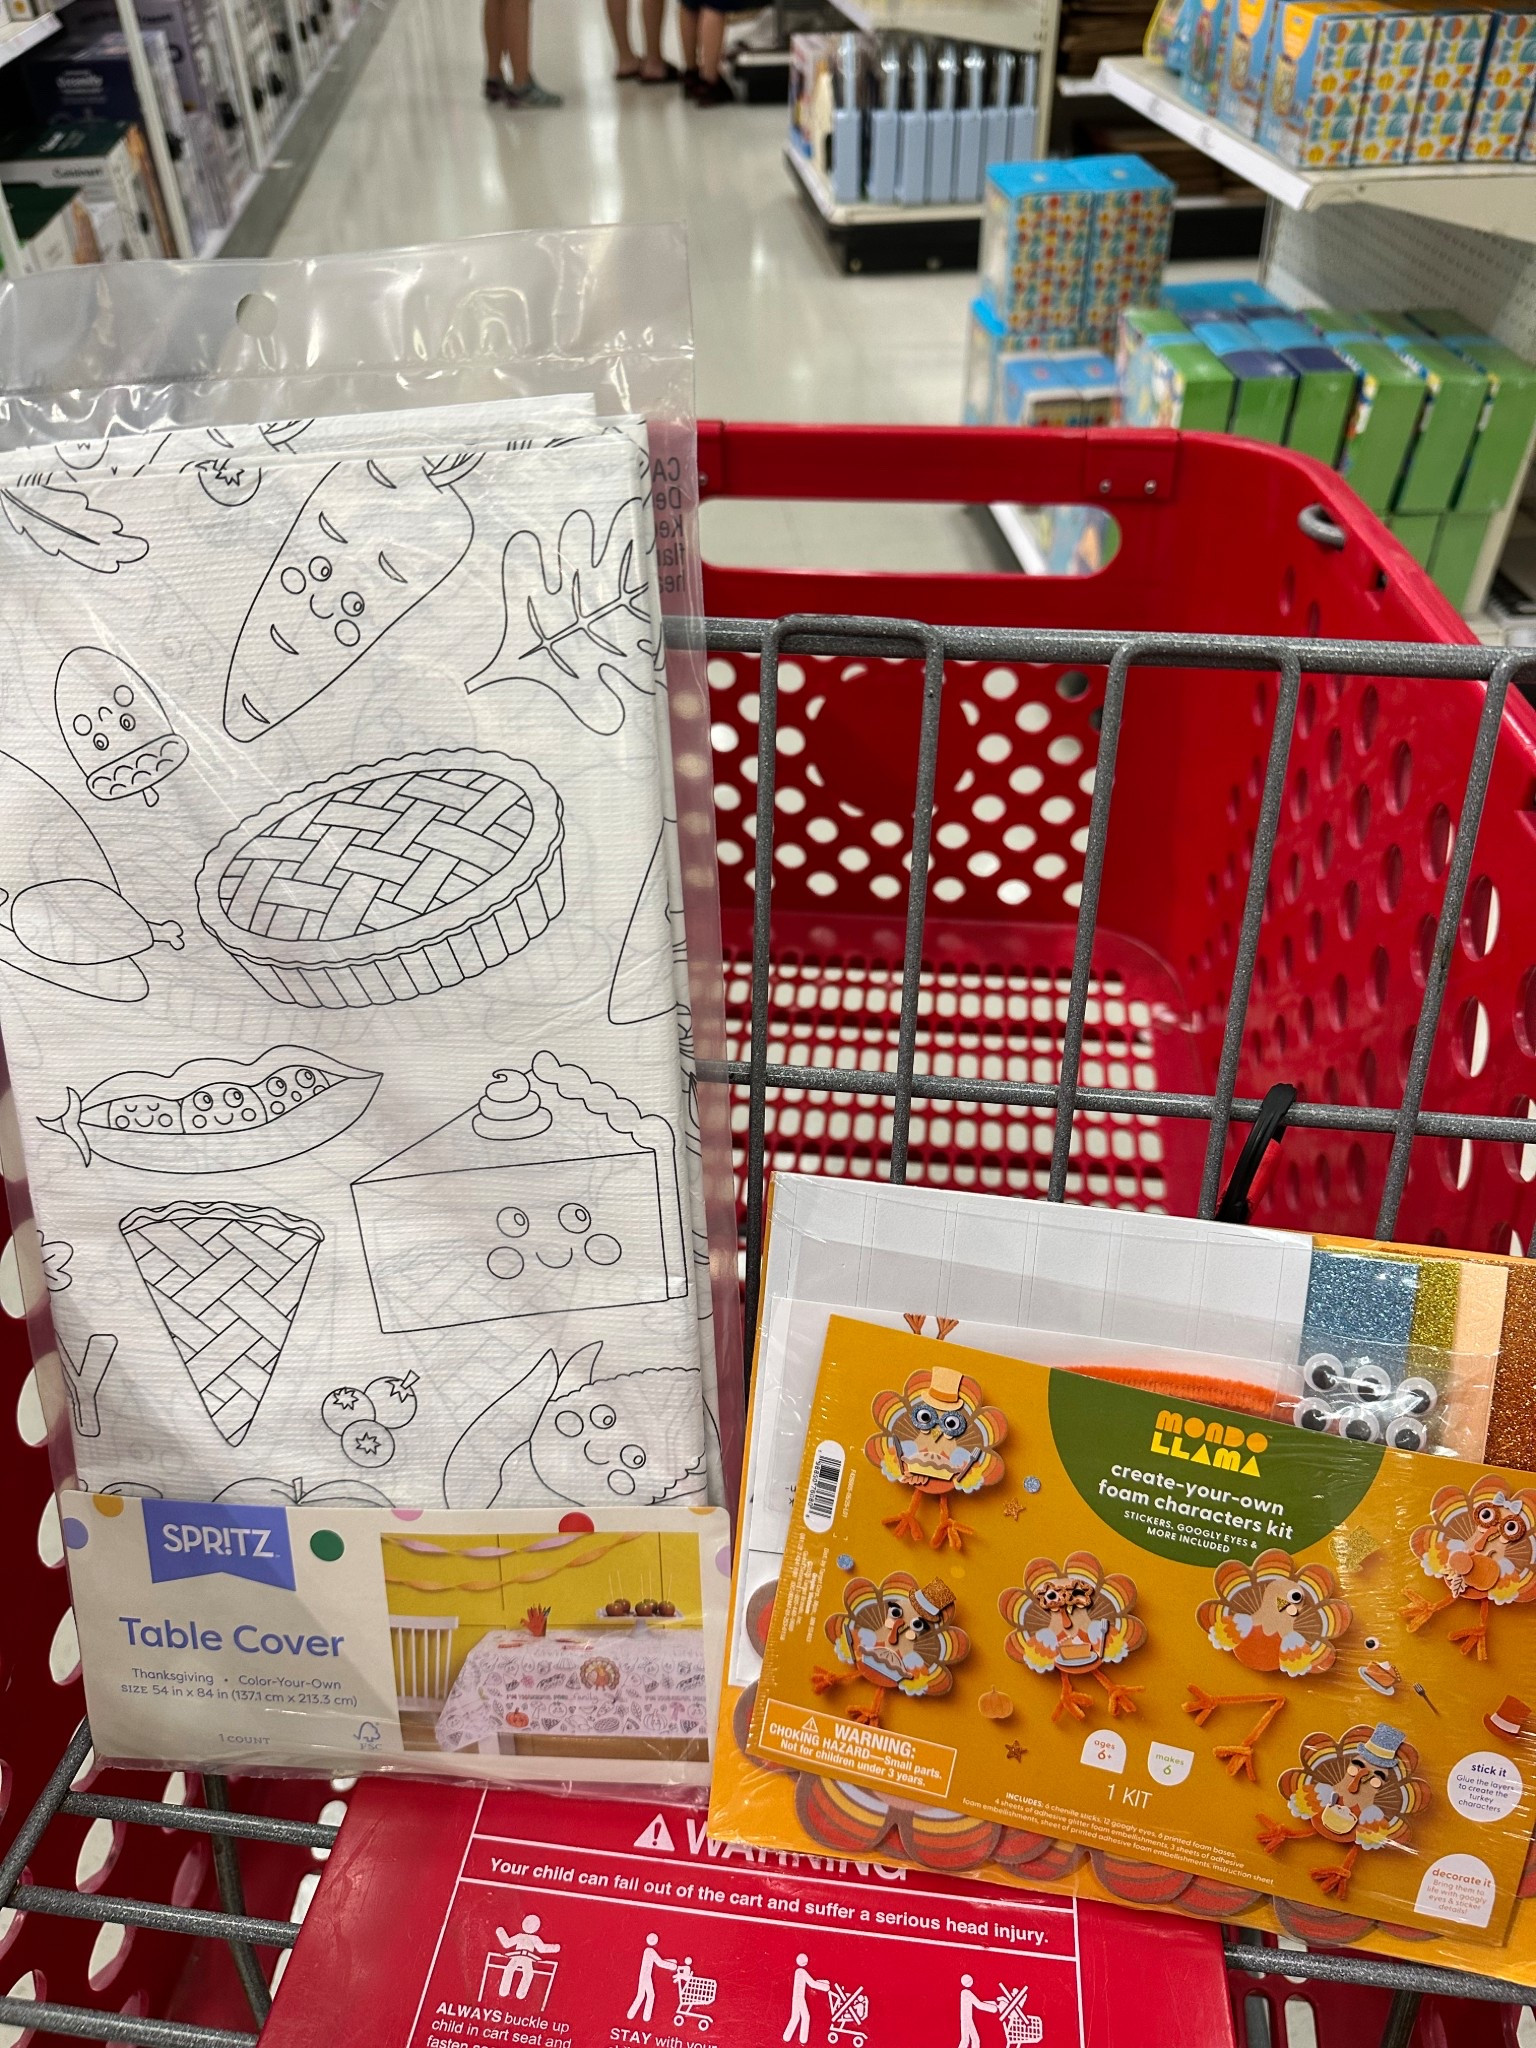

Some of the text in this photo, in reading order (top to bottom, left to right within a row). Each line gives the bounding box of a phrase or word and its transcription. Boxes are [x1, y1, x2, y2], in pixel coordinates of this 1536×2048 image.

[1155, 1410, 1268, 1453] MONDO
[1151, 1431, 1260, 1477] LLAMA
[1111, 1464, 1284, 1516] create-your-own
[1099, 1479, 1294, 1540] foam characters kit
[1146, 1526, 1229, 1552] MORE INCLUDED
[1177, 1523, 1221, 1539] GOOGLY
[1223, 1534, 1247, 1546] EYES
[1250, 1540, 1257, 1548] &
[118, 1616, 344, 1657] Table Cover
[132, 1668, 341, 1690] Thanksgiving Color-Your-Own
[121, 1684, 148, 1694] SIZE
[153, 1685, 168, 1694] 54
[172, 1686, 183, 1696] in
[198, 1688, 214, 1698] 84
[217, 1689, 228, 1699] in
[266, 1693, 284, 1702] cm
[299, 1694, 330, 1704] 213.3
[334, 1696, 357, 1707] cm)
[227, 1736, 270, 1744] COUNT
[769, 1723, 819, 1745] CHOKING
[913, 1765, 941, 1778] parts.
[835, 1724, 915, 1757] WARNING:
[1094, 1740, 1116, 1750] ages
[780, 1738, 925, 1785] Not for children under 3 years.
[1156, 1753, 1184, 1766] makes
[1164, 1765, 1171, 1775] 6
[1471, 1764, 1506, 1777] stick it
[1456, 1774, 1474, 1783] Glue
[1476, 1778, 1489, 1786] the
[1468, 1786, 1493, 1795] create
[1495, 1790, 1508, 1798] the
[1108, 1784, 1152, 1808] 1 KIT
[1458, 1799, 1500, 1812] characters
[1469, 1793, 1493, 1803] turkey
[1006, 1792, 1042, 1807] INCLUDES:
[1050, 1805, 1078, 1816] chenille
[1106, 1819, 1137, 1832] googly
[1163, 1835, 1191, 1845] printed
[1192, 1841, 1211, 1850] foam
[962, 1797, 981, 1807] foam
[1040, 1819, 1060, 1828] sheet
[1070, 1827, 1097, 1838] printed
[1098, 1834, 1131, 1847] adhesive
[1132, 1842, 1152, 1852] foam
[1212, 1863, 1251, 1878] instruction
[1253, 1875, 1273, 1884] sheet
[1000, 1800, 1023, 1810] sheets
[1033, 1809, 1066, 1822] adhesive
[1067, 1818, 1089, 1827] glitter
[1091, 1823, 1110, 1832] foam
[1176, 1846, 1199, 1856] sheets
[1210, 1855, 1244, 1868] adhesive
[1432, 1868, 1491, 1887] decorate it
[1432, 1879, 1453, 1890] Bring
[1455, 1884, 1474, 1893] them
[491, 1857, 1048, 1945] Your child can fall out of the cart and suffer a serious head injury.
[1428, 1894, 1446, 1902] eyes
[1455, 1900, 1480, 1909] sticker
[1459, 1894, 1486, 1904] googly
[436, 2002, 569, 2033] ALWAYS buckle up
[432, 2020, 572, 2048] child in cart seat and
[610, 2028, 652, 2045] STAY
[655, 2036, 682, 2048] with
